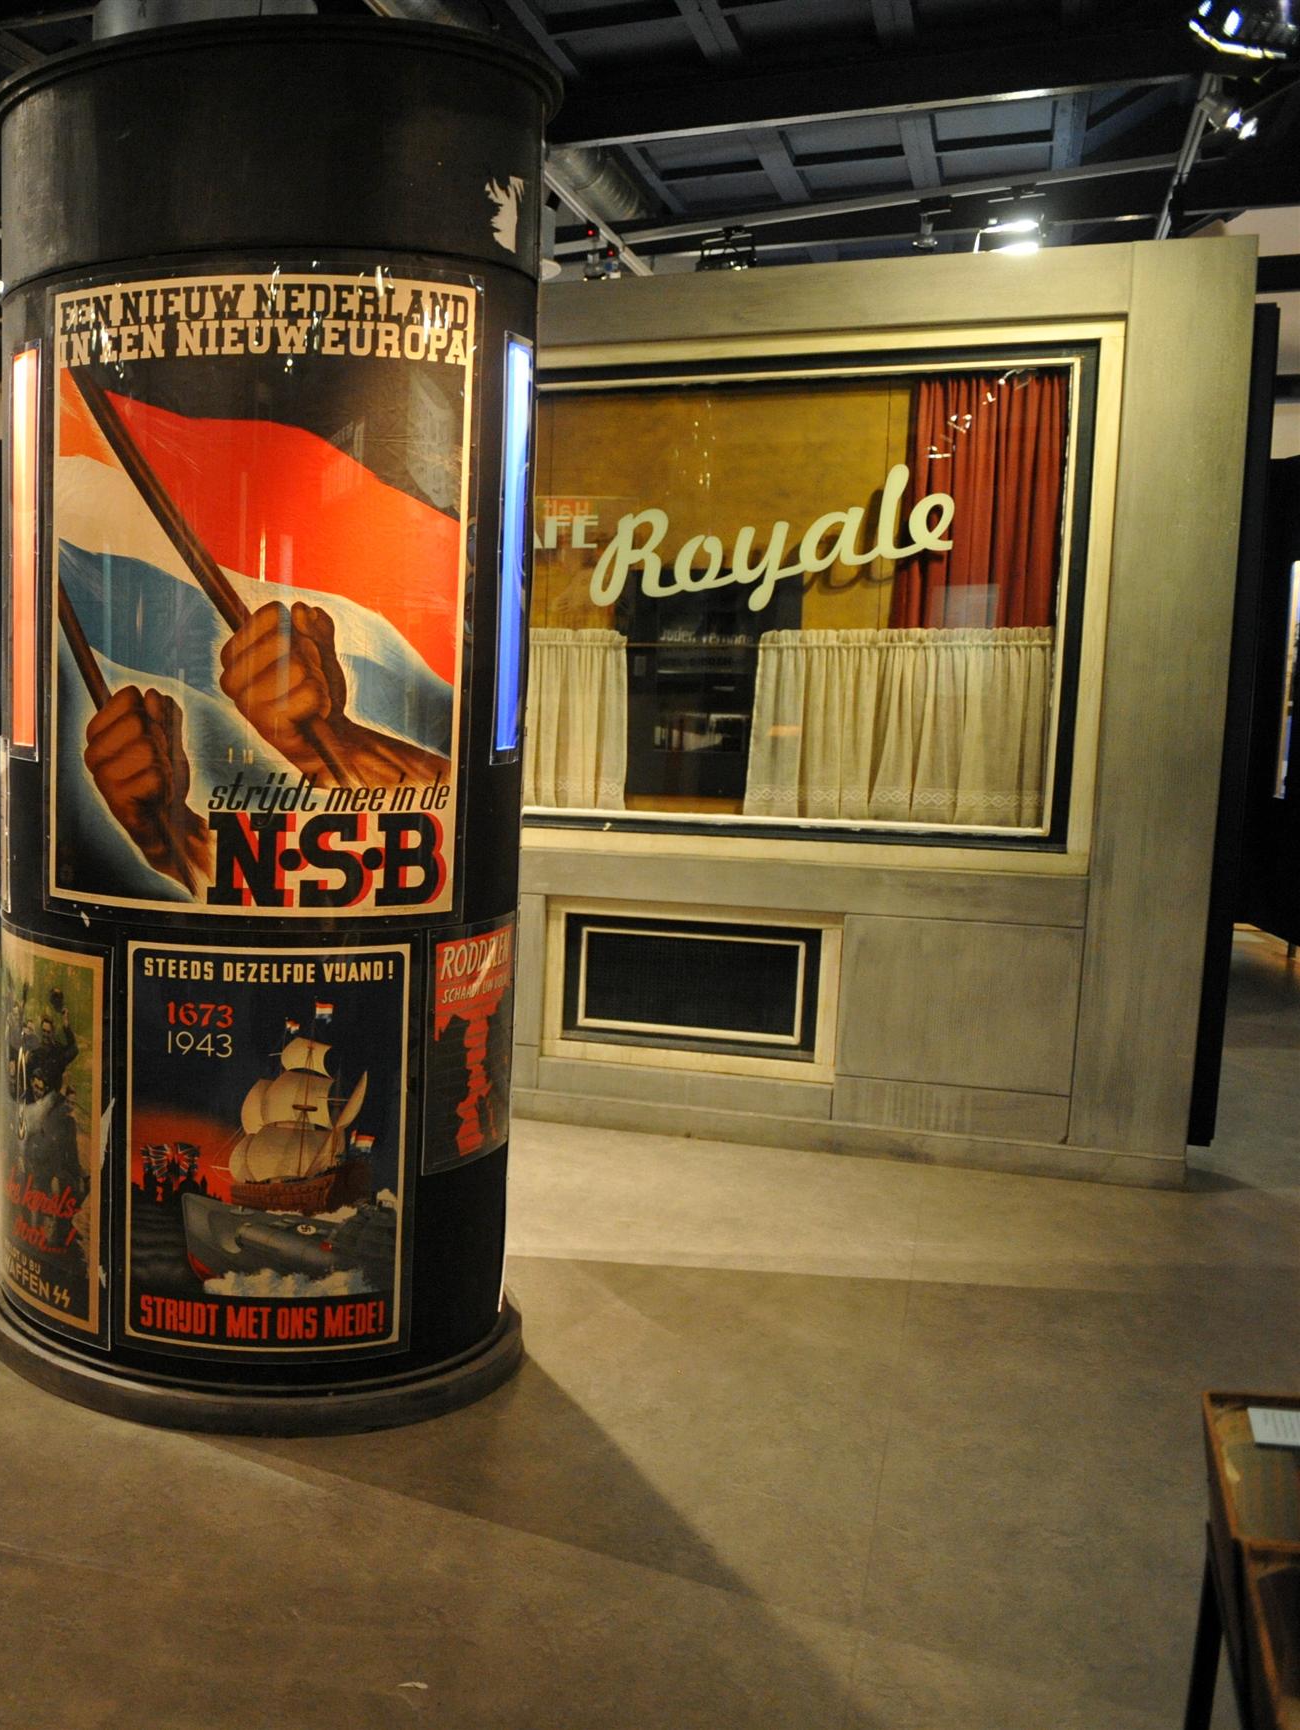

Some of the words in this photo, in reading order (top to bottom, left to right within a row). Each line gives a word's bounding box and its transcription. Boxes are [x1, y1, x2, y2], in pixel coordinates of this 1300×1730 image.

[60, 294, 113, 335] EEN
[120, 284, 246, 326] NIEUW
[253, 283, 470, 331] NEDERLAND
[60, 332, 91, 367] IN
[99, 322, 166, 364] EEN
[176, 318, 307, 357] NIEUW
[321, 319, 469, 366] EUROPA
[589, 464, 955, 612] Royale
[207, 772, 319, 829] strijdt
[324, 786, 387, 812] mee
[389, 773, 415, 812] in
[420, 770, 450, 811] de
[143, 956, 214, 981] STEEDS
[223, 962, 316, 984] DEZELFDE
[166, 999, 234, 1029] 1673
[166, 1029, 233, 1059] 1943
[140, 1294, 220, 1337] STRIJDT
[226, 1304, 272, 1340] MET
[276, 1305, 318, 1341] ONS
[323, 1300, 386, 1339] MEDE!
